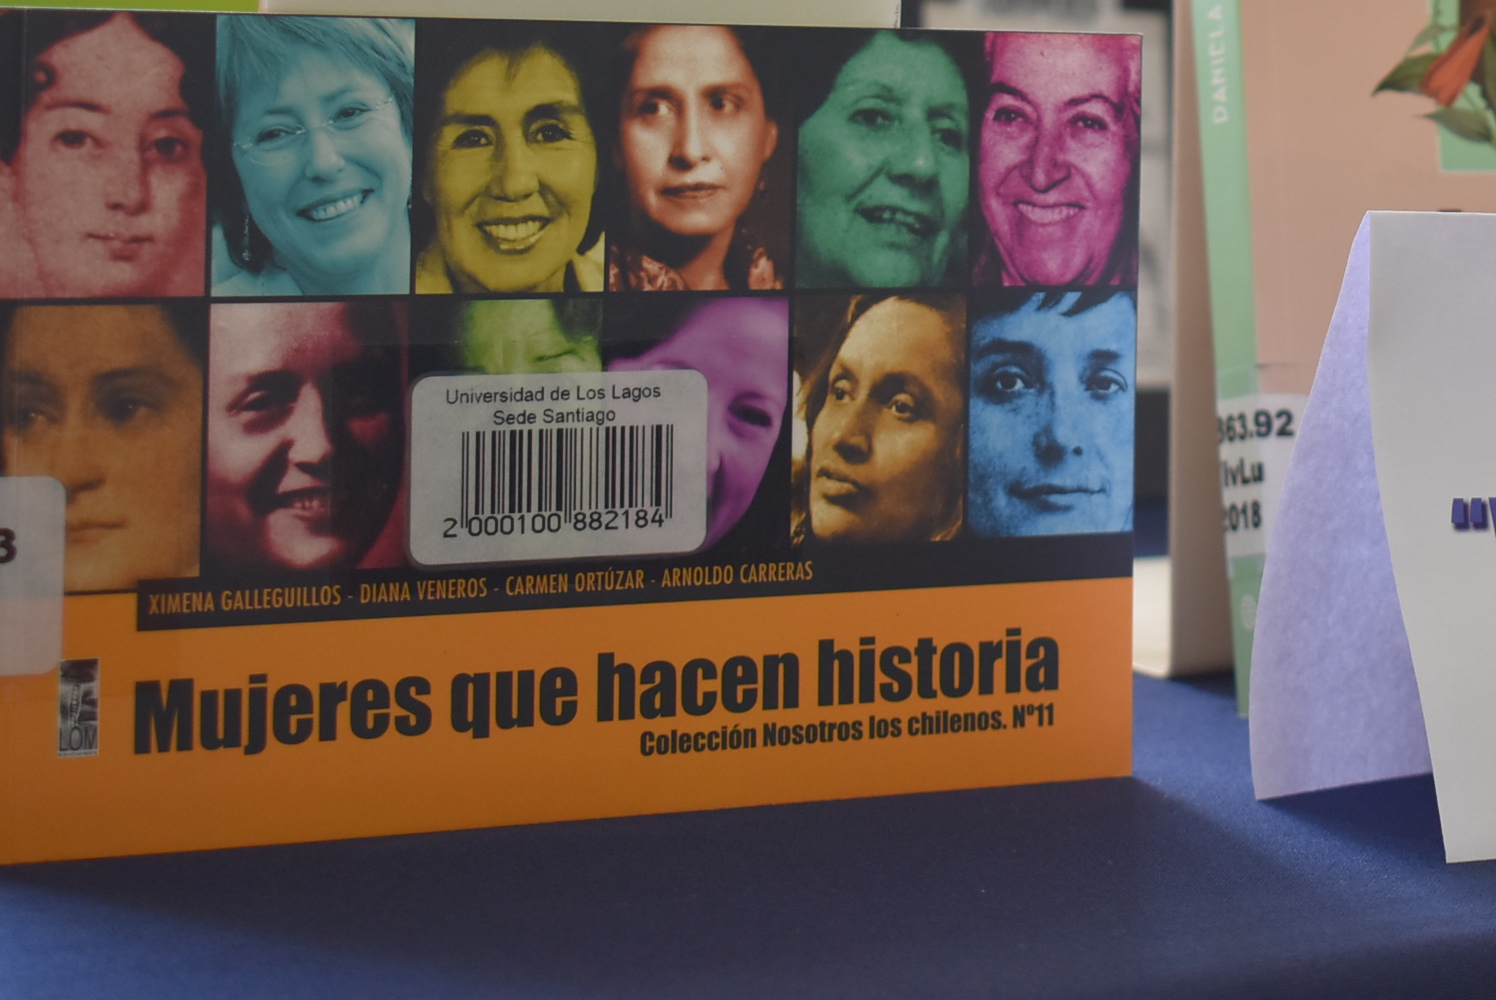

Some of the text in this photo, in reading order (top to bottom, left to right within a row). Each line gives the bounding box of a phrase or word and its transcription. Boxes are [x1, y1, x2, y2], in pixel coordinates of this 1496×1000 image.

[1207, 4, 1229, 124] DANIELA
[446, 384, 661, 404] Universidad de Los Lagos
[493, 407, 617, 426] Sede Santiago
[443, 507, 665, 538] 2 000100 882184
[149, 591, 215, 615] XIMENA
[220, 585, 342, 612] GALLEGUILLOS
[360, 581, 411, 604] DIANA
[416, 576, 488, 601] VENEROS
[505, 573, 569, 596] CARMEN
[574, 566, 646, 593] ORTÚZAR
[660, 564, 735, 588] ARNOLDO
[740, 560, 814, 584] CARRERAS
[133, 627, 1060, 757] Mujeres que hacen historia
[59, 726, 98, 752] LOM
[639, 724, 758, 757] Colección
[763, 717, 863, 748] Nosotros
[868, 714, 902, 740] los
[907, 708, 1008, 737] chilenos.
